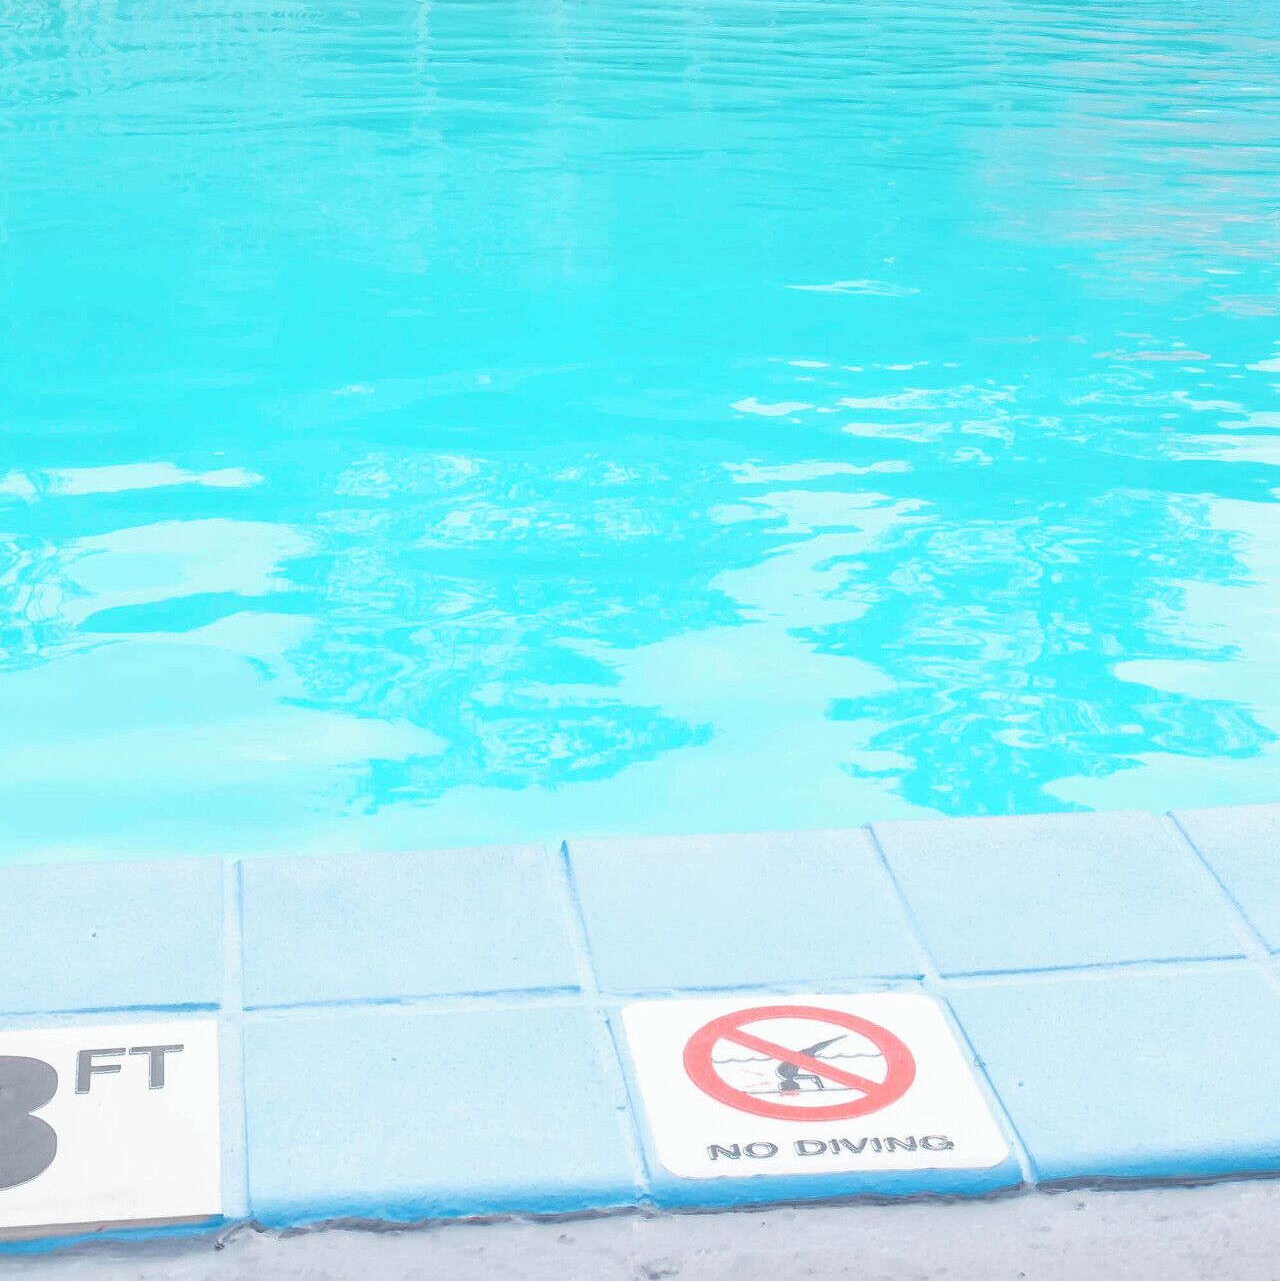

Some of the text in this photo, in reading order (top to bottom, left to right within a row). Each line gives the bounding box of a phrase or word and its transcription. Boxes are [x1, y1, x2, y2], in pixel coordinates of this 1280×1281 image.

[75, 1044, 184, 1094] FT
[706, 1134, 955, 1161] NO DIVING
